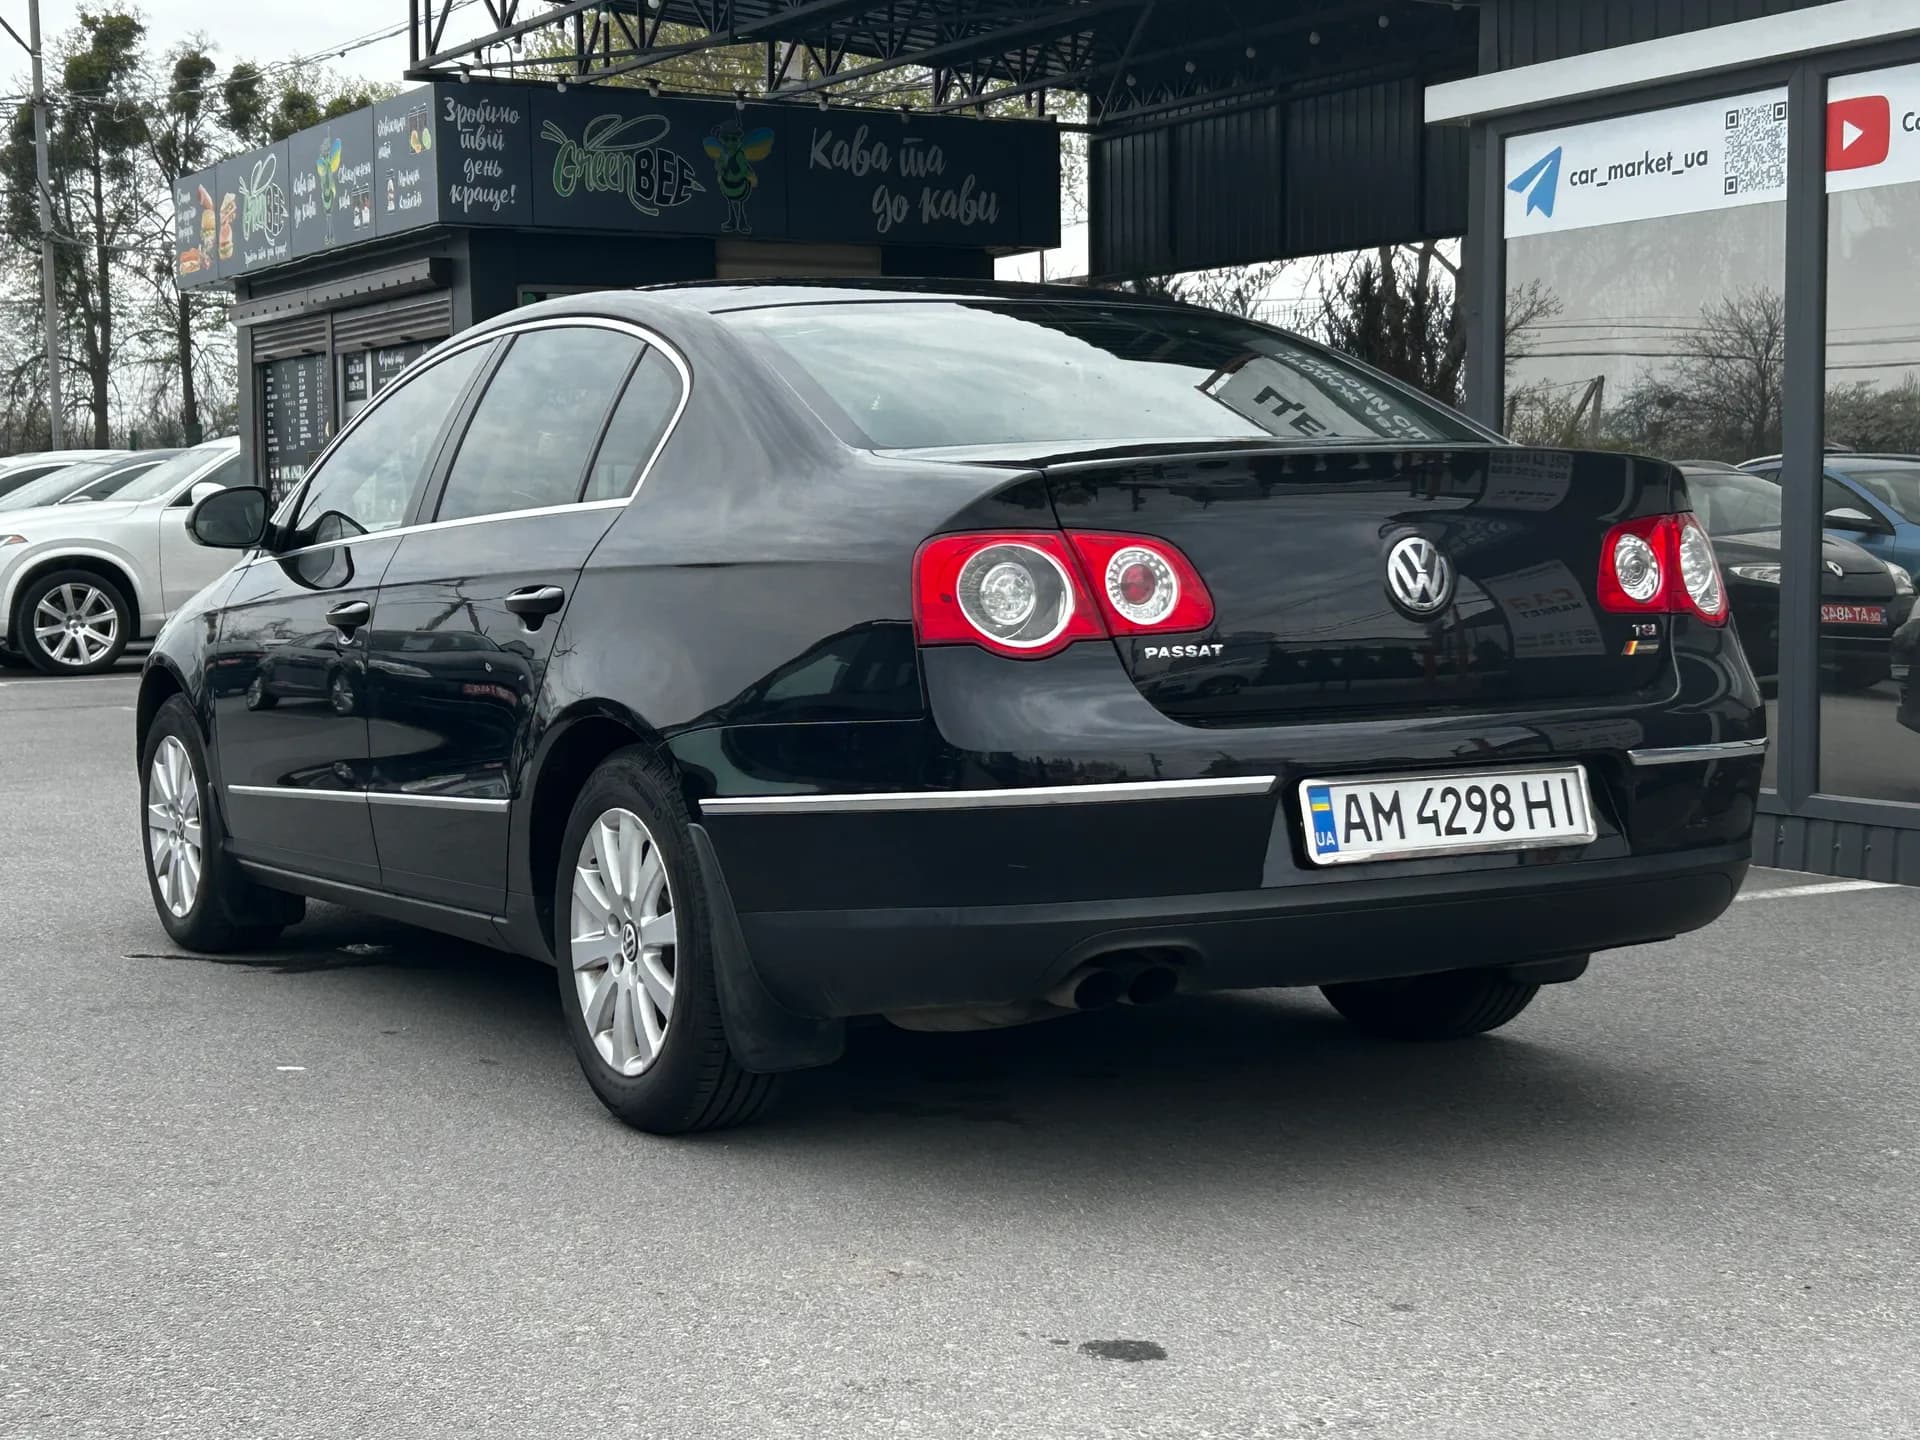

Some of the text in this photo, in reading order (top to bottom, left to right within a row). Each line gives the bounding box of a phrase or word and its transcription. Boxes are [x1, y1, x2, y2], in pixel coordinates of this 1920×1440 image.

[809, 125, 946, 177] Кава та
[463, 158, 503, 183] день
[1569, 149, 1709, 187] car_market_ua
[449, 184, 516, 213] краще!
[871, 173, 1001, 234] до кави
[1144, 643, 1224, 660] PASSAT
[1343, 777, 1575, 844] AM 4298 HI
[1315, 831, 1336, 848] UA
